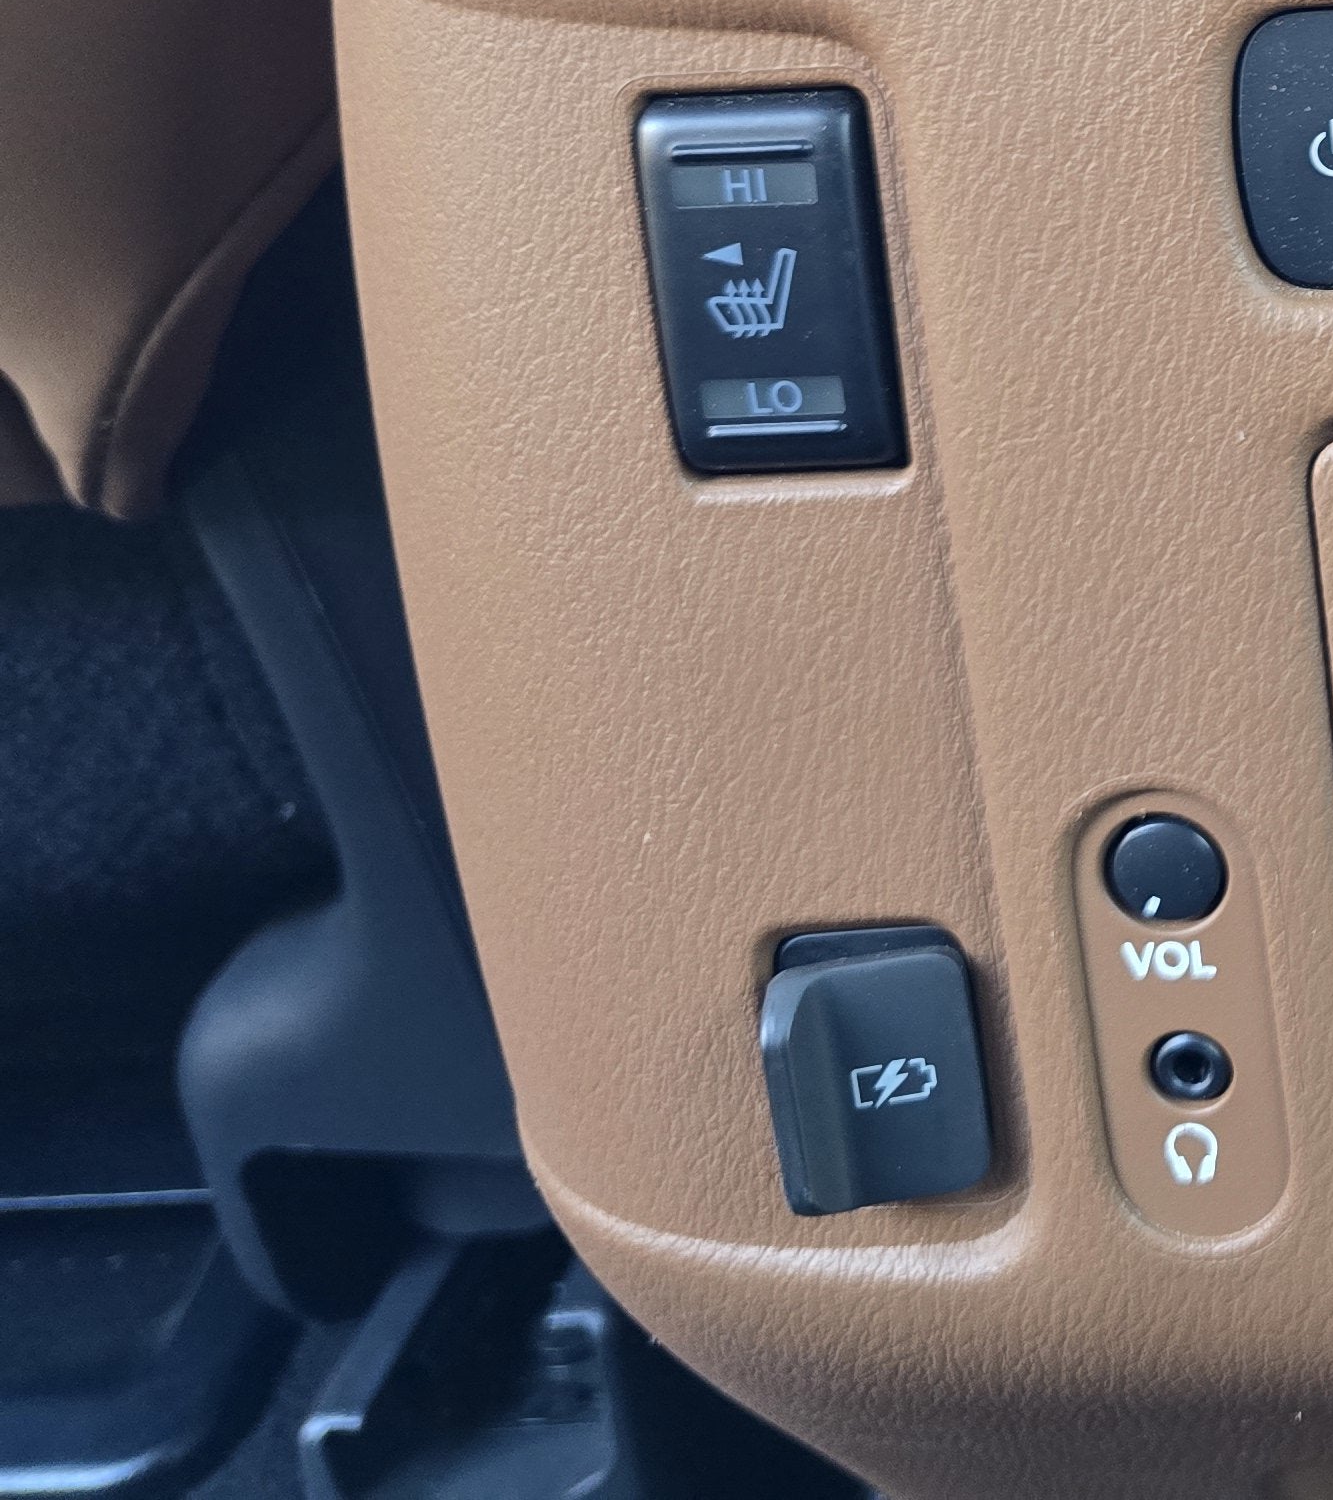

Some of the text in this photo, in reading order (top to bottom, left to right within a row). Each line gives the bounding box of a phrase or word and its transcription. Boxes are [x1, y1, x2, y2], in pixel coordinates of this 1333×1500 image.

[724, 167, 768, 203] HI
[747, 379, 803, 416] LO
[1120, 940, 1217, 981] VOL
